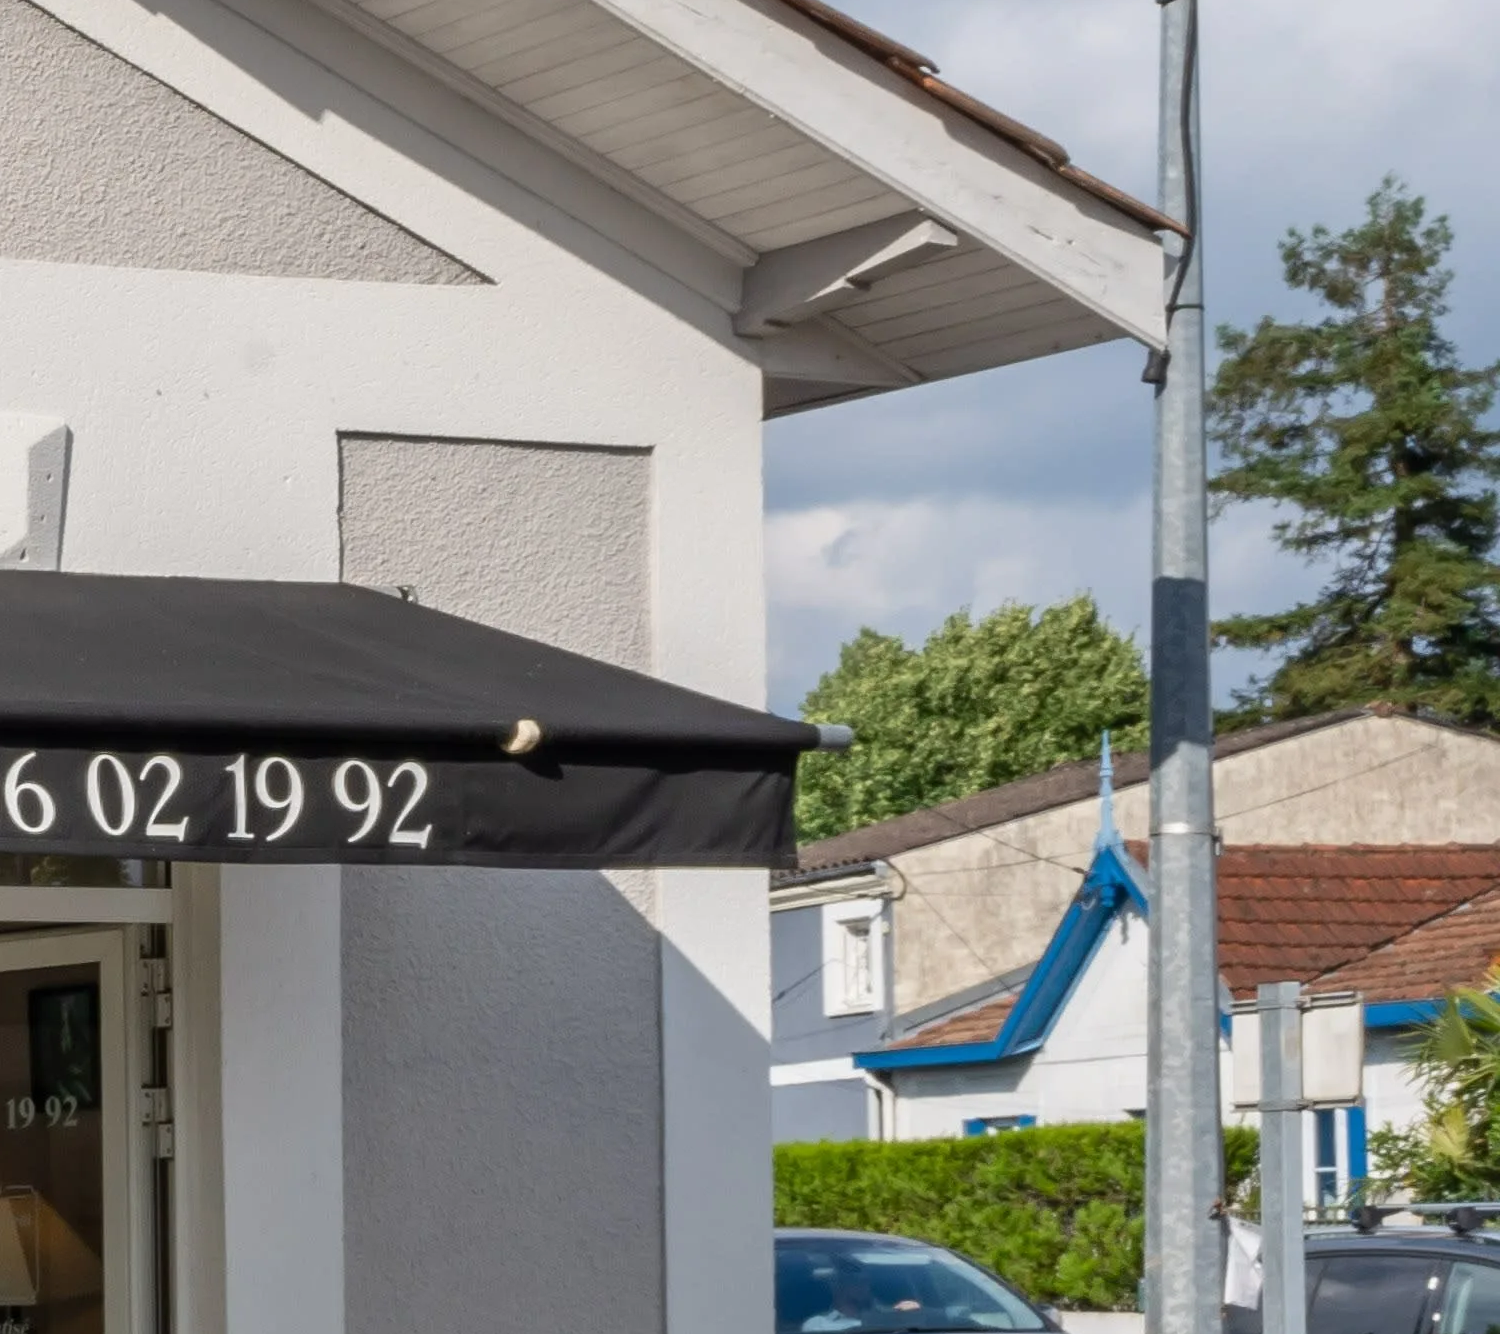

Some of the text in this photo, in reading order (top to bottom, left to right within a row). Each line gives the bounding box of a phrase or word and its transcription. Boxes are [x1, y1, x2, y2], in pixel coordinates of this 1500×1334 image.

[86, 752, 190, 843] 02
[225, 753, 303, 842] 19
[333, 759, 433, 850] 92
[6, 1097, 36, 1130] 19
[45, 1095, 78, 1127] 92
